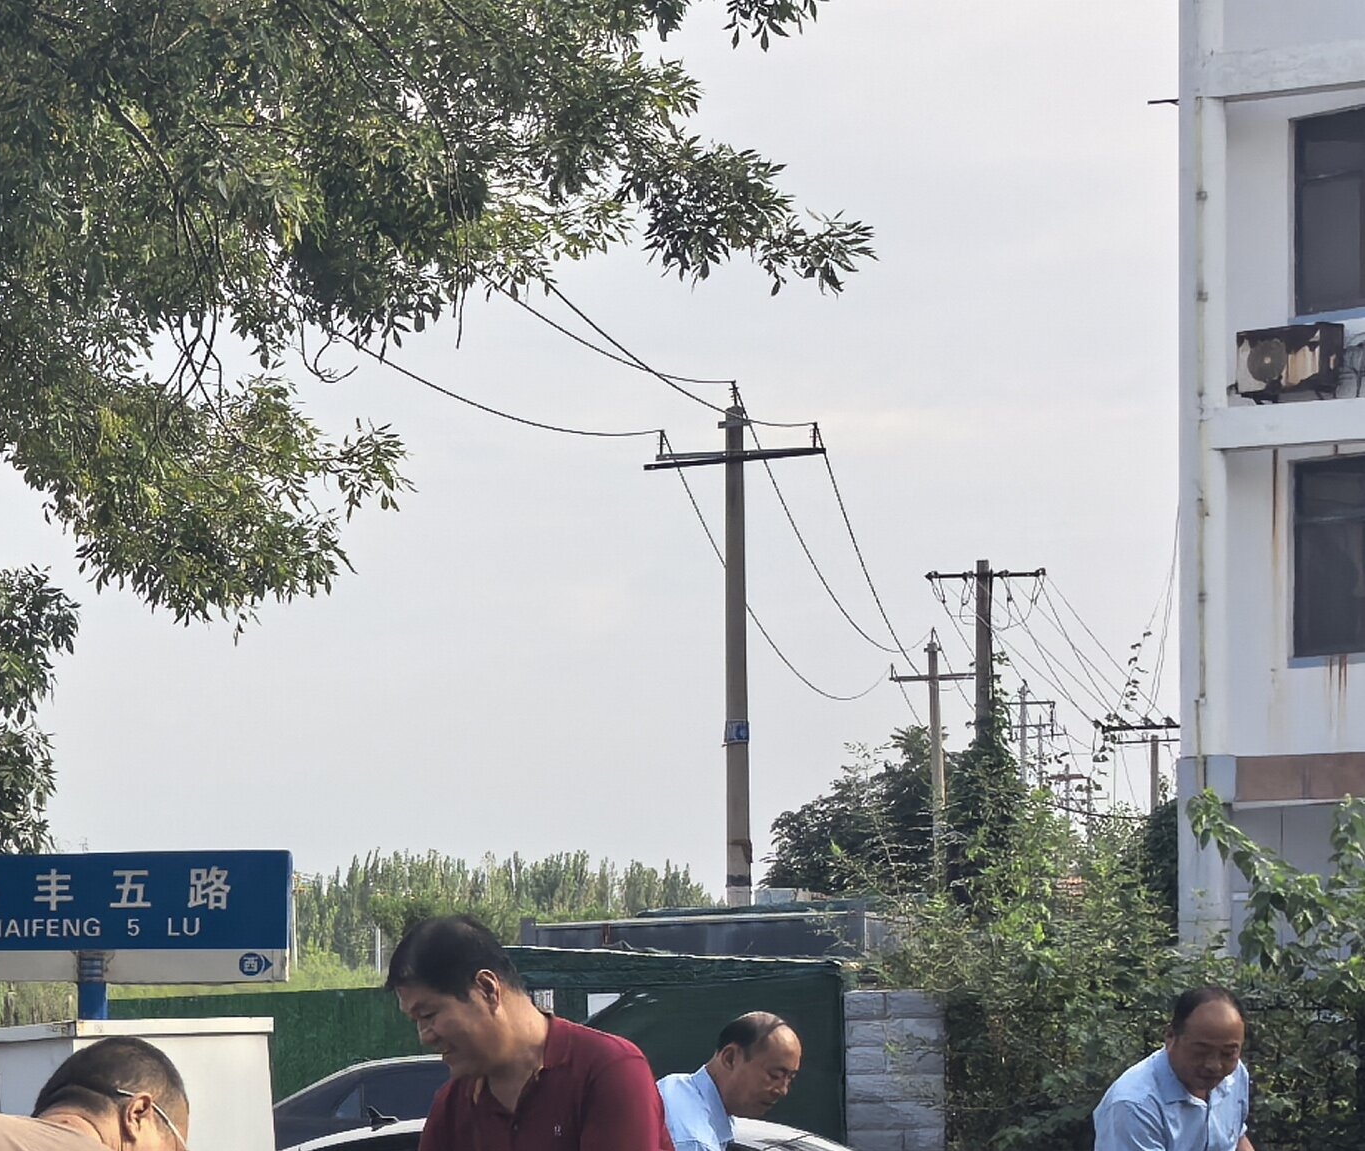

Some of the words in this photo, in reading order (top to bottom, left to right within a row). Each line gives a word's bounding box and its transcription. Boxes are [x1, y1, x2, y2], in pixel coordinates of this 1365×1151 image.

[127, 918, 141, 937] 5
[167, 917, 202, 937] LU
[242, 956, 260, 974] 西
